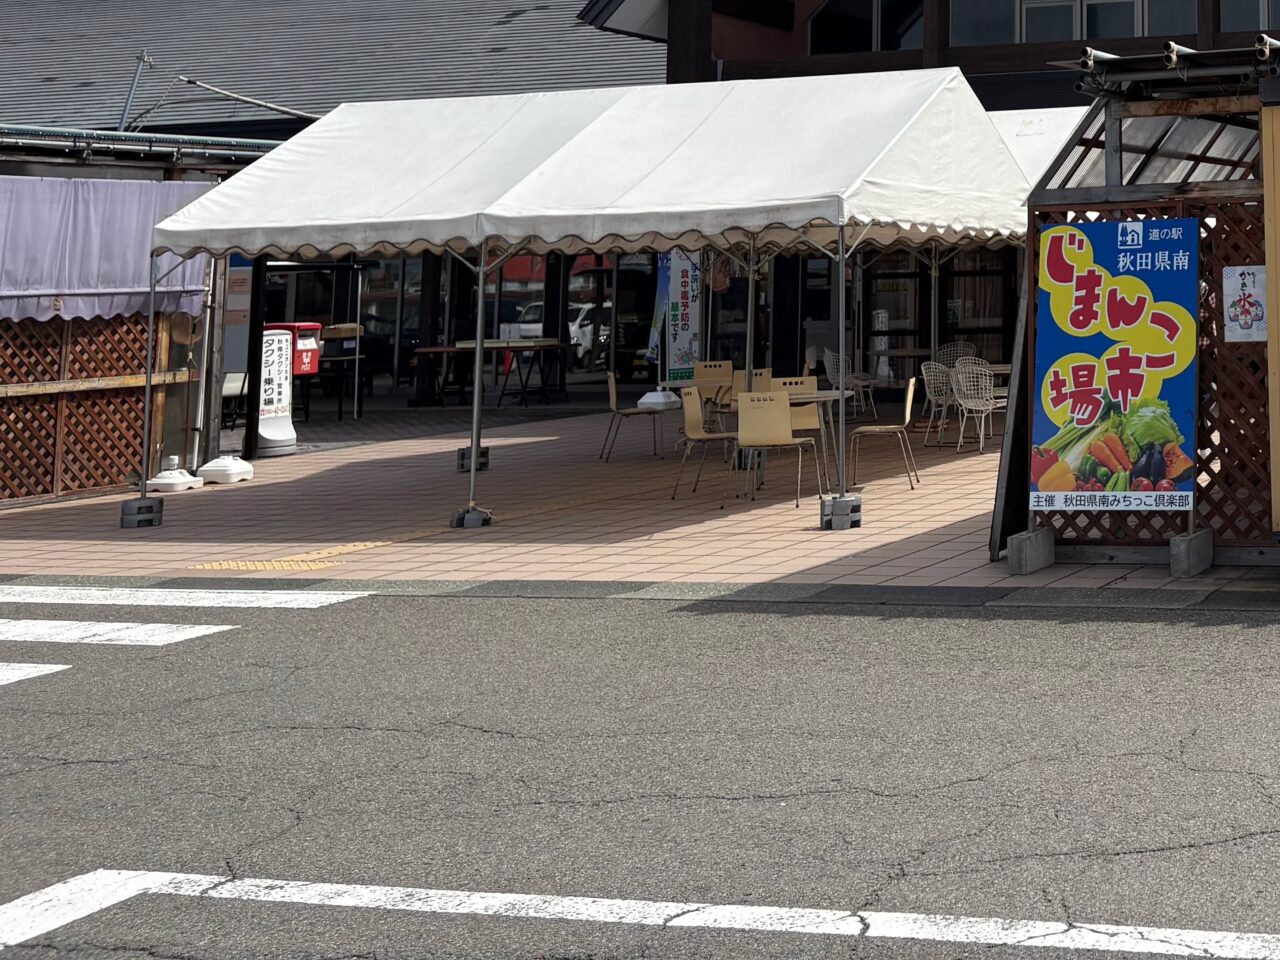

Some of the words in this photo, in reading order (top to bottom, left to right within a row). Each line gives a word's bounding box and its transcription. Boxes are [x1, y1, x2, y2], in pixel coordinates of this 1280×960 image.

[1148, 227, 1183, 241] 道の駅
[1117, 250, 1190, 272] 秋田県南
[680, 268, 690, 332] 食中毒予防の
[670, 301, 679, 342] 基本です
[263, 338, 275, 406] タクシー乗り場
[1033, 495, 1056, 508] 主催
[1063, 495, 1190, 508] 秋田県南みちっこ倶楽部
